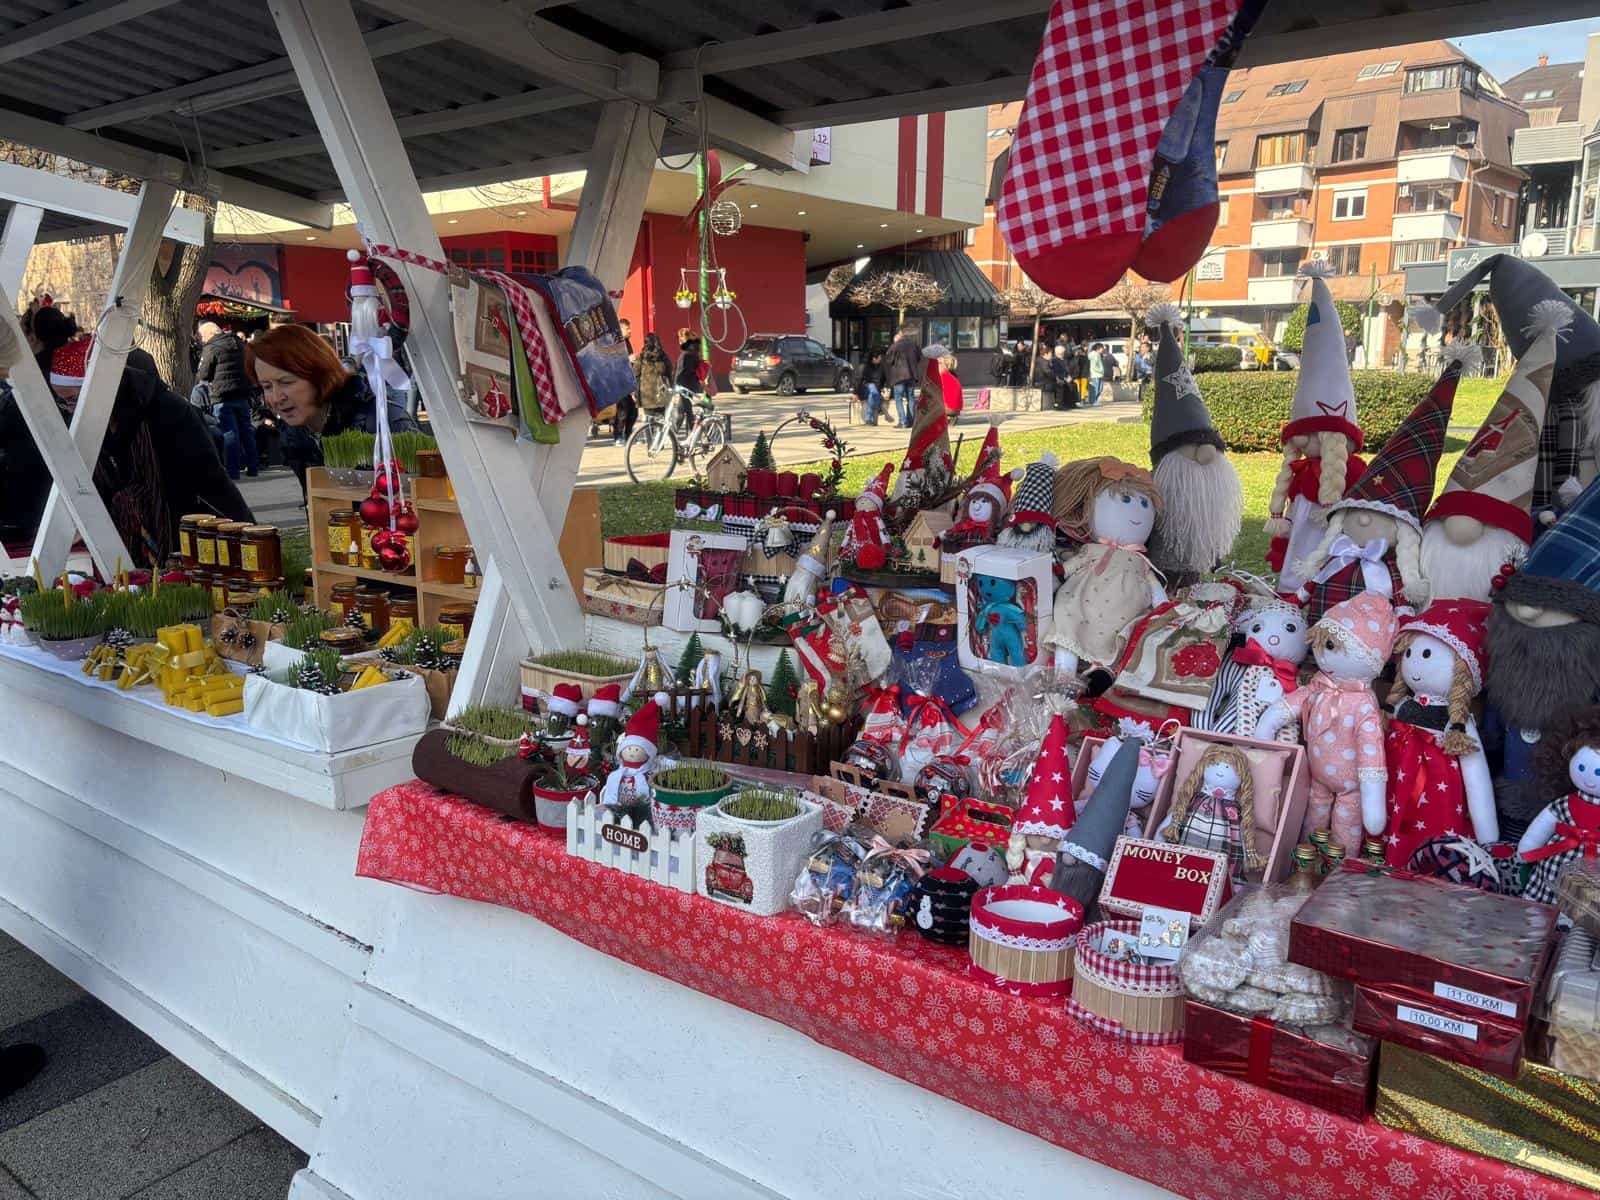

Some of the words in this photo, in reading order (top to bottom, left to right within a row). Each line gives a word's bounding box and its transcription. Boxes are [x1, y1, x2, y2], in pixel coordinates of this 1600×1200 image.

[606, 827, 641, 849] HOME
[1124, 845, 1187, 865] MONEY
[1174, 866, 1211, 885] BOX
